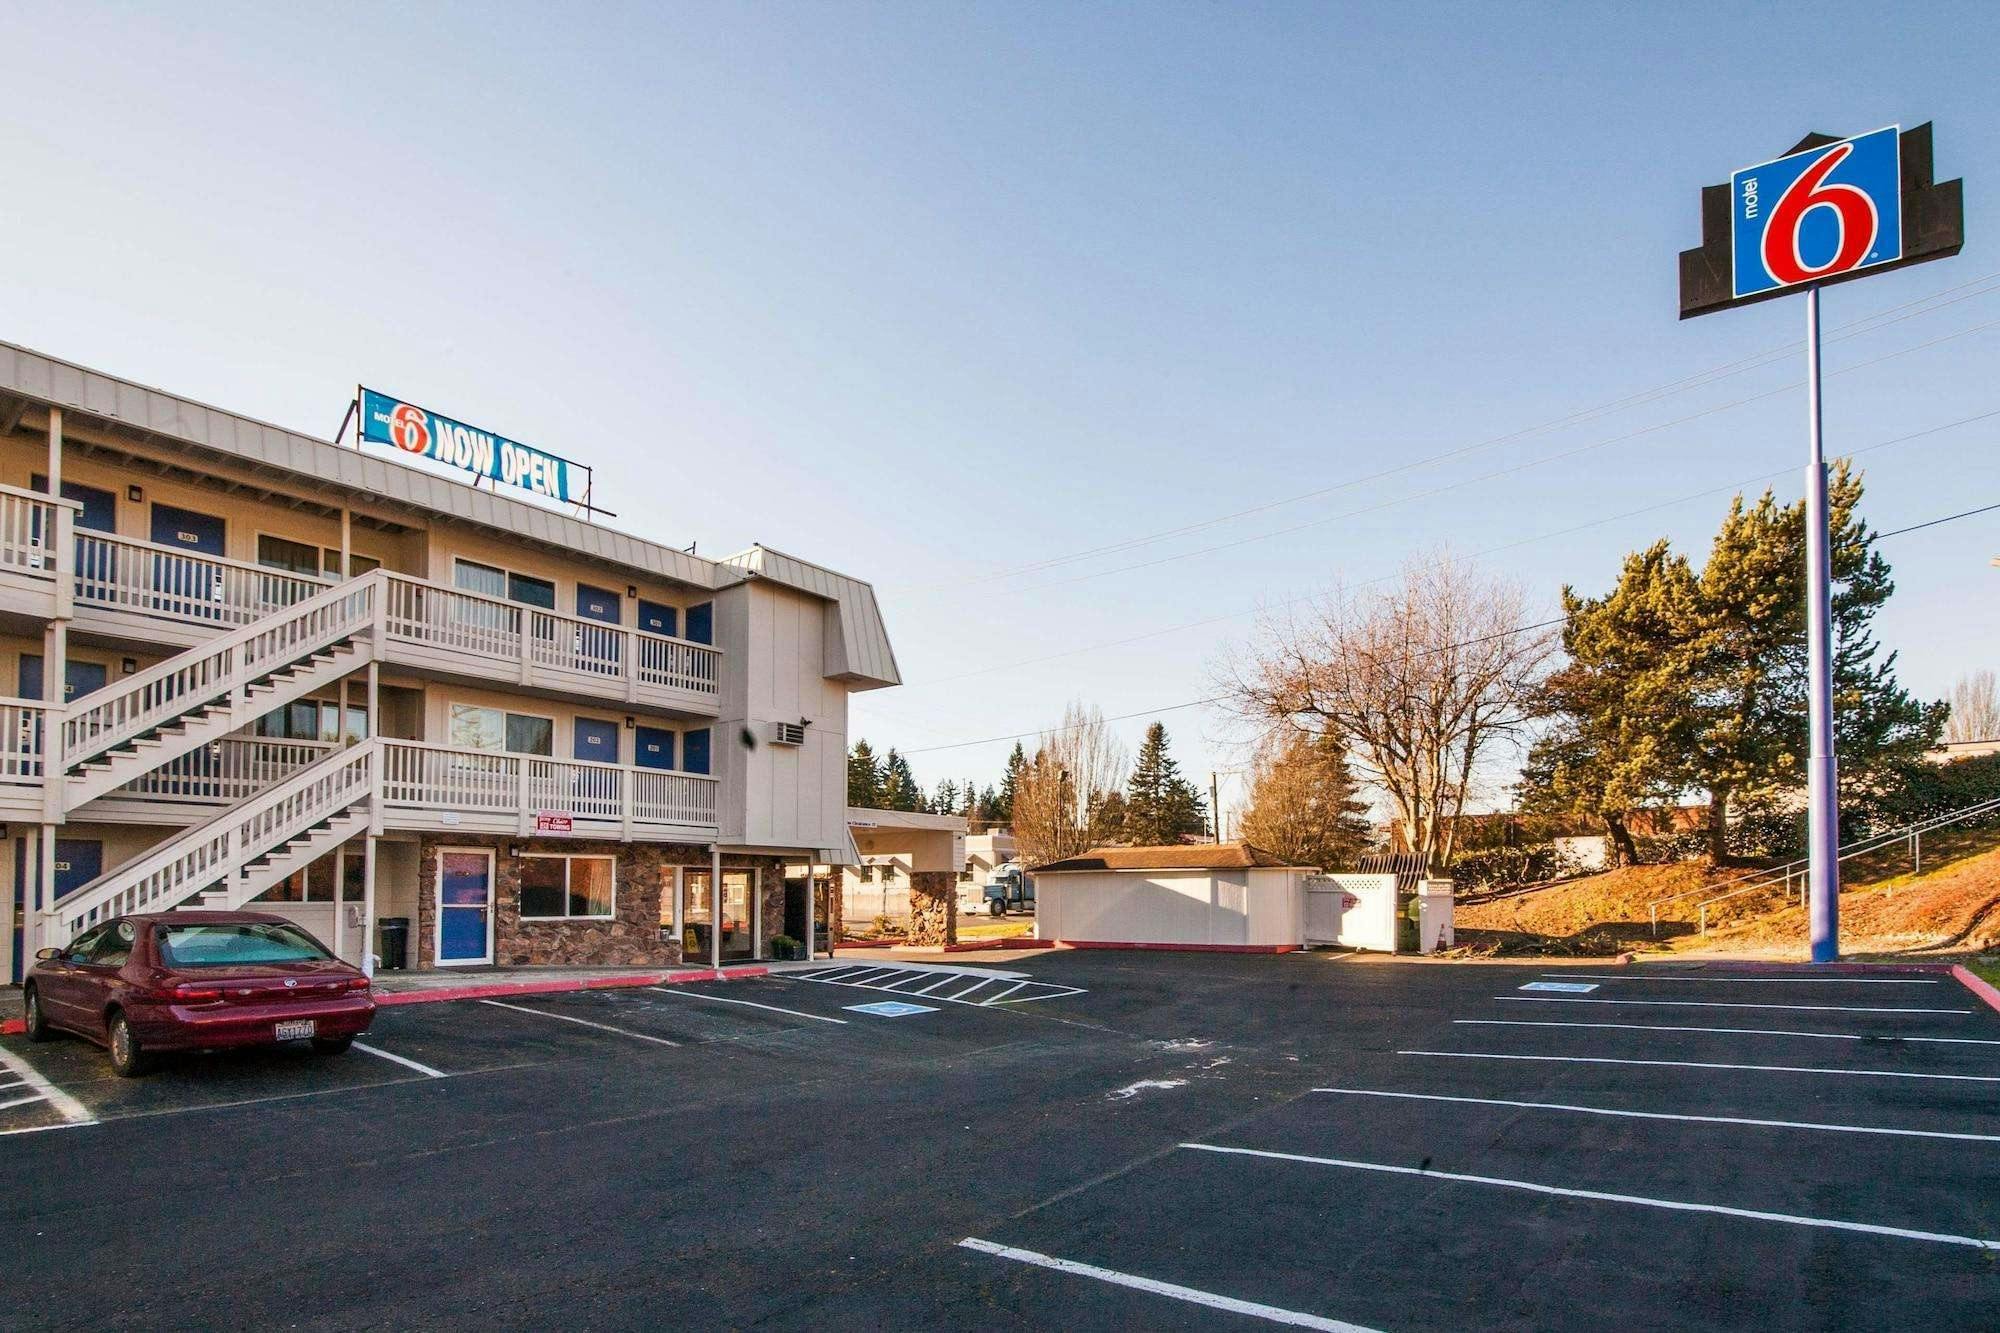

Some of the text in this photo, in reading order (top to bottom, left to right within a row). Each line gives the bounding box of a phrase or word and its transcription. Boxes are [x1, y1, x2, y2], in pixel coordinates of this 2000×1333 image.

[1742, 177, 1758, 219] motel
[1760, 142, 1879, 286] 6
[390, 402, 431, 456] 6
[434, 418, 495, 477] NOW
[500, 441, 561, 499] OPEN
